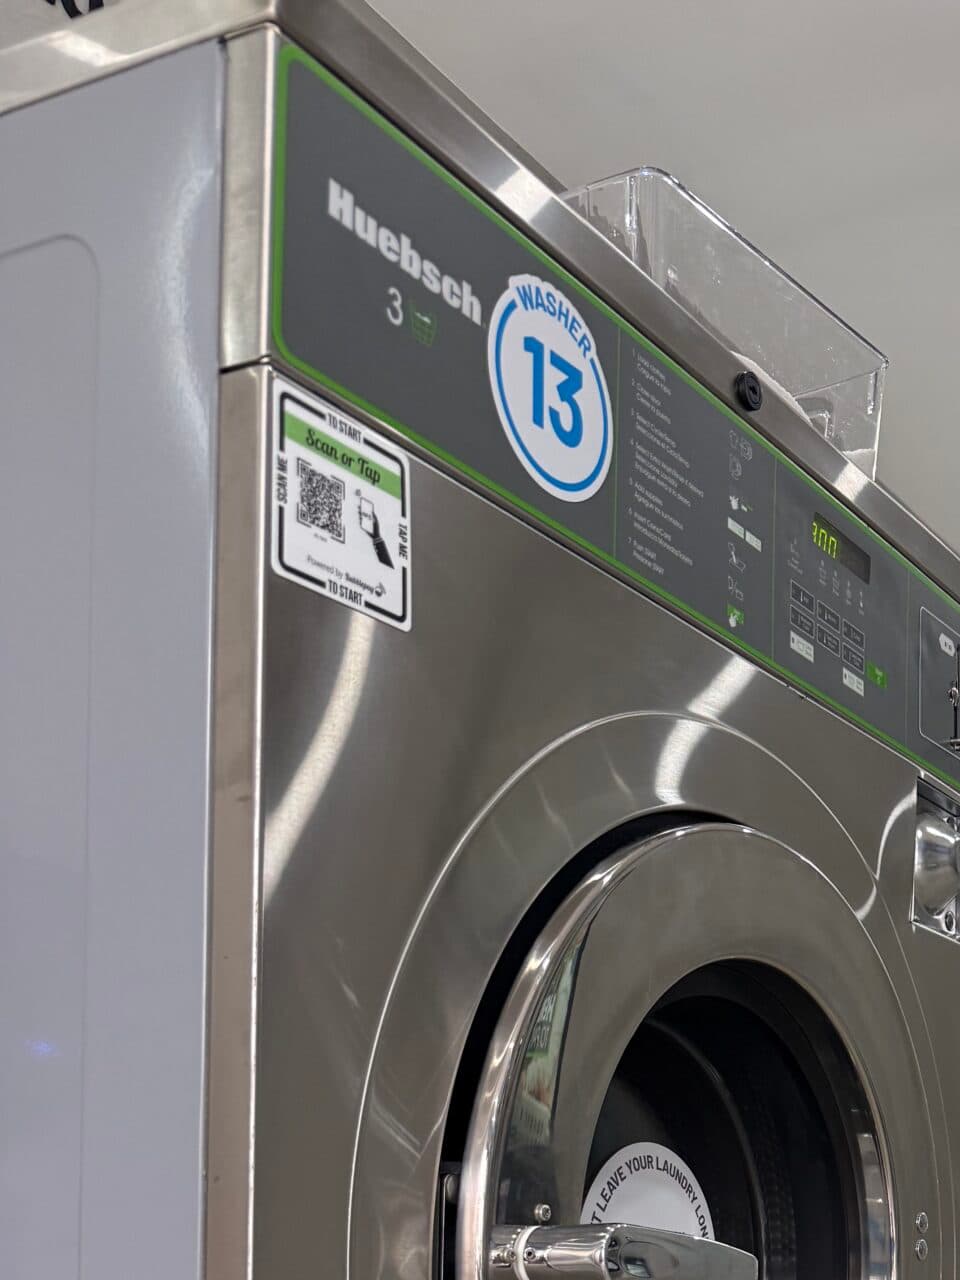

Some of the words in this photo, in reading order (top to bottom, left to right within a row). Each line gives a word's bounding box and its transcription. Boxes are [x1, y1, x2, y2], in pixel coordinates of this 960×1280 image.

[327, 177, 482, 327] Huebsch
[386, 286, 404, 326] 3
[516, 284, 592, 357] WASHER
[523, 336, 583, 449] 13
[328, 414, 339, 429] TO
[339, 416, 362, 443] START
[277, 457, 288, 473] ME
[306, 428, 339, 461] Scan
[341, 455, 355, 468] or
[357, 458, 381, 487] Tap
[277, 475, 288, 504] SCAN
[398, 522, 408, 547] TAP
[399, 543, 408, 560] ME
[328, 579, 338, 595] TO
[339, 584, 363, 606] START
[597, 1166, 627, 1212] LEAVE
[625, 1155, 654, 1175] YOUR
[655, 1156, 698, 1204] LAUNDRY
[695, 1204, 709, 1239] LON
